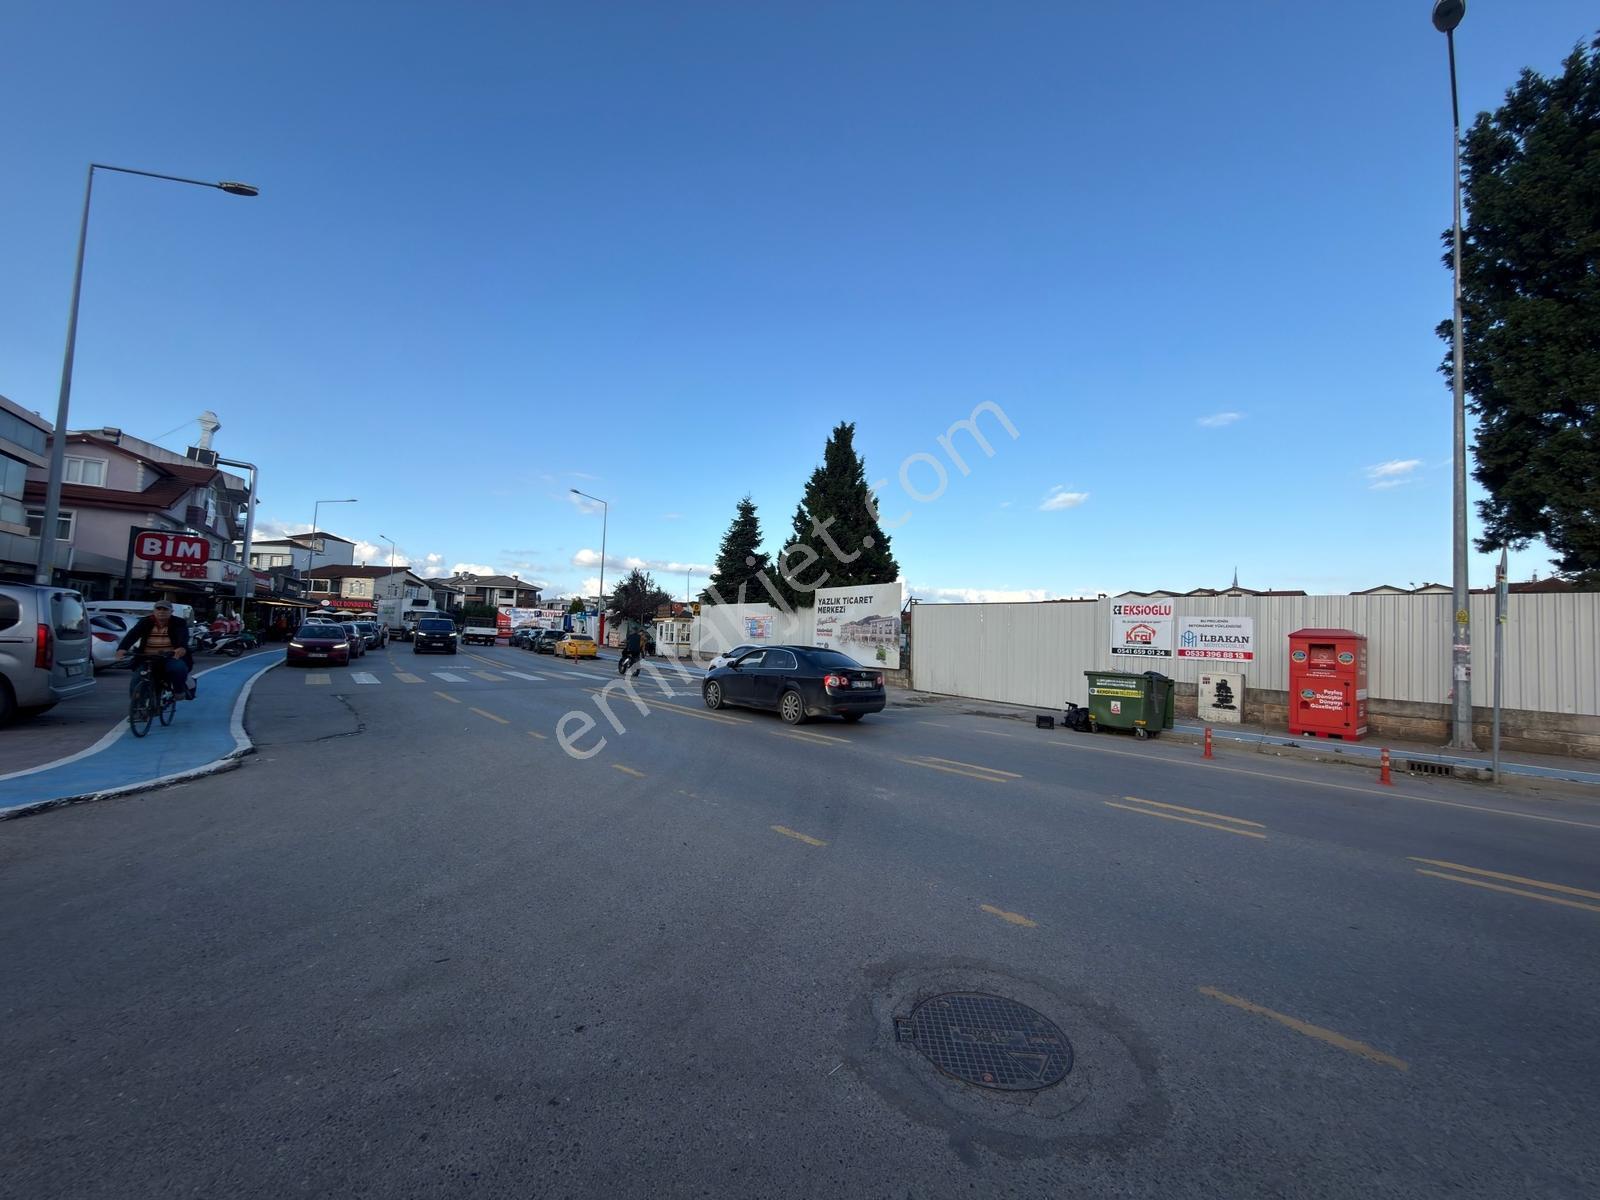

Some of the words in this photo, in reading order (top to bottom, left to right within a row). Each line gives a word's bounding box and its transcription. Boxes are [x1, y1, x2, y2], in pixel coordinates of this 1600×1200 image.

[142, 535, 201, 559] BİM
[817, 597, 841, 606] YAZLIK
[843, 595, 874, 605] TİCARET
[817, 605, 846, 614] MERKEZİ
[1126, 631, 1152, 641] Kral
[1200, 632, 1250, 644] İLBAKAN
